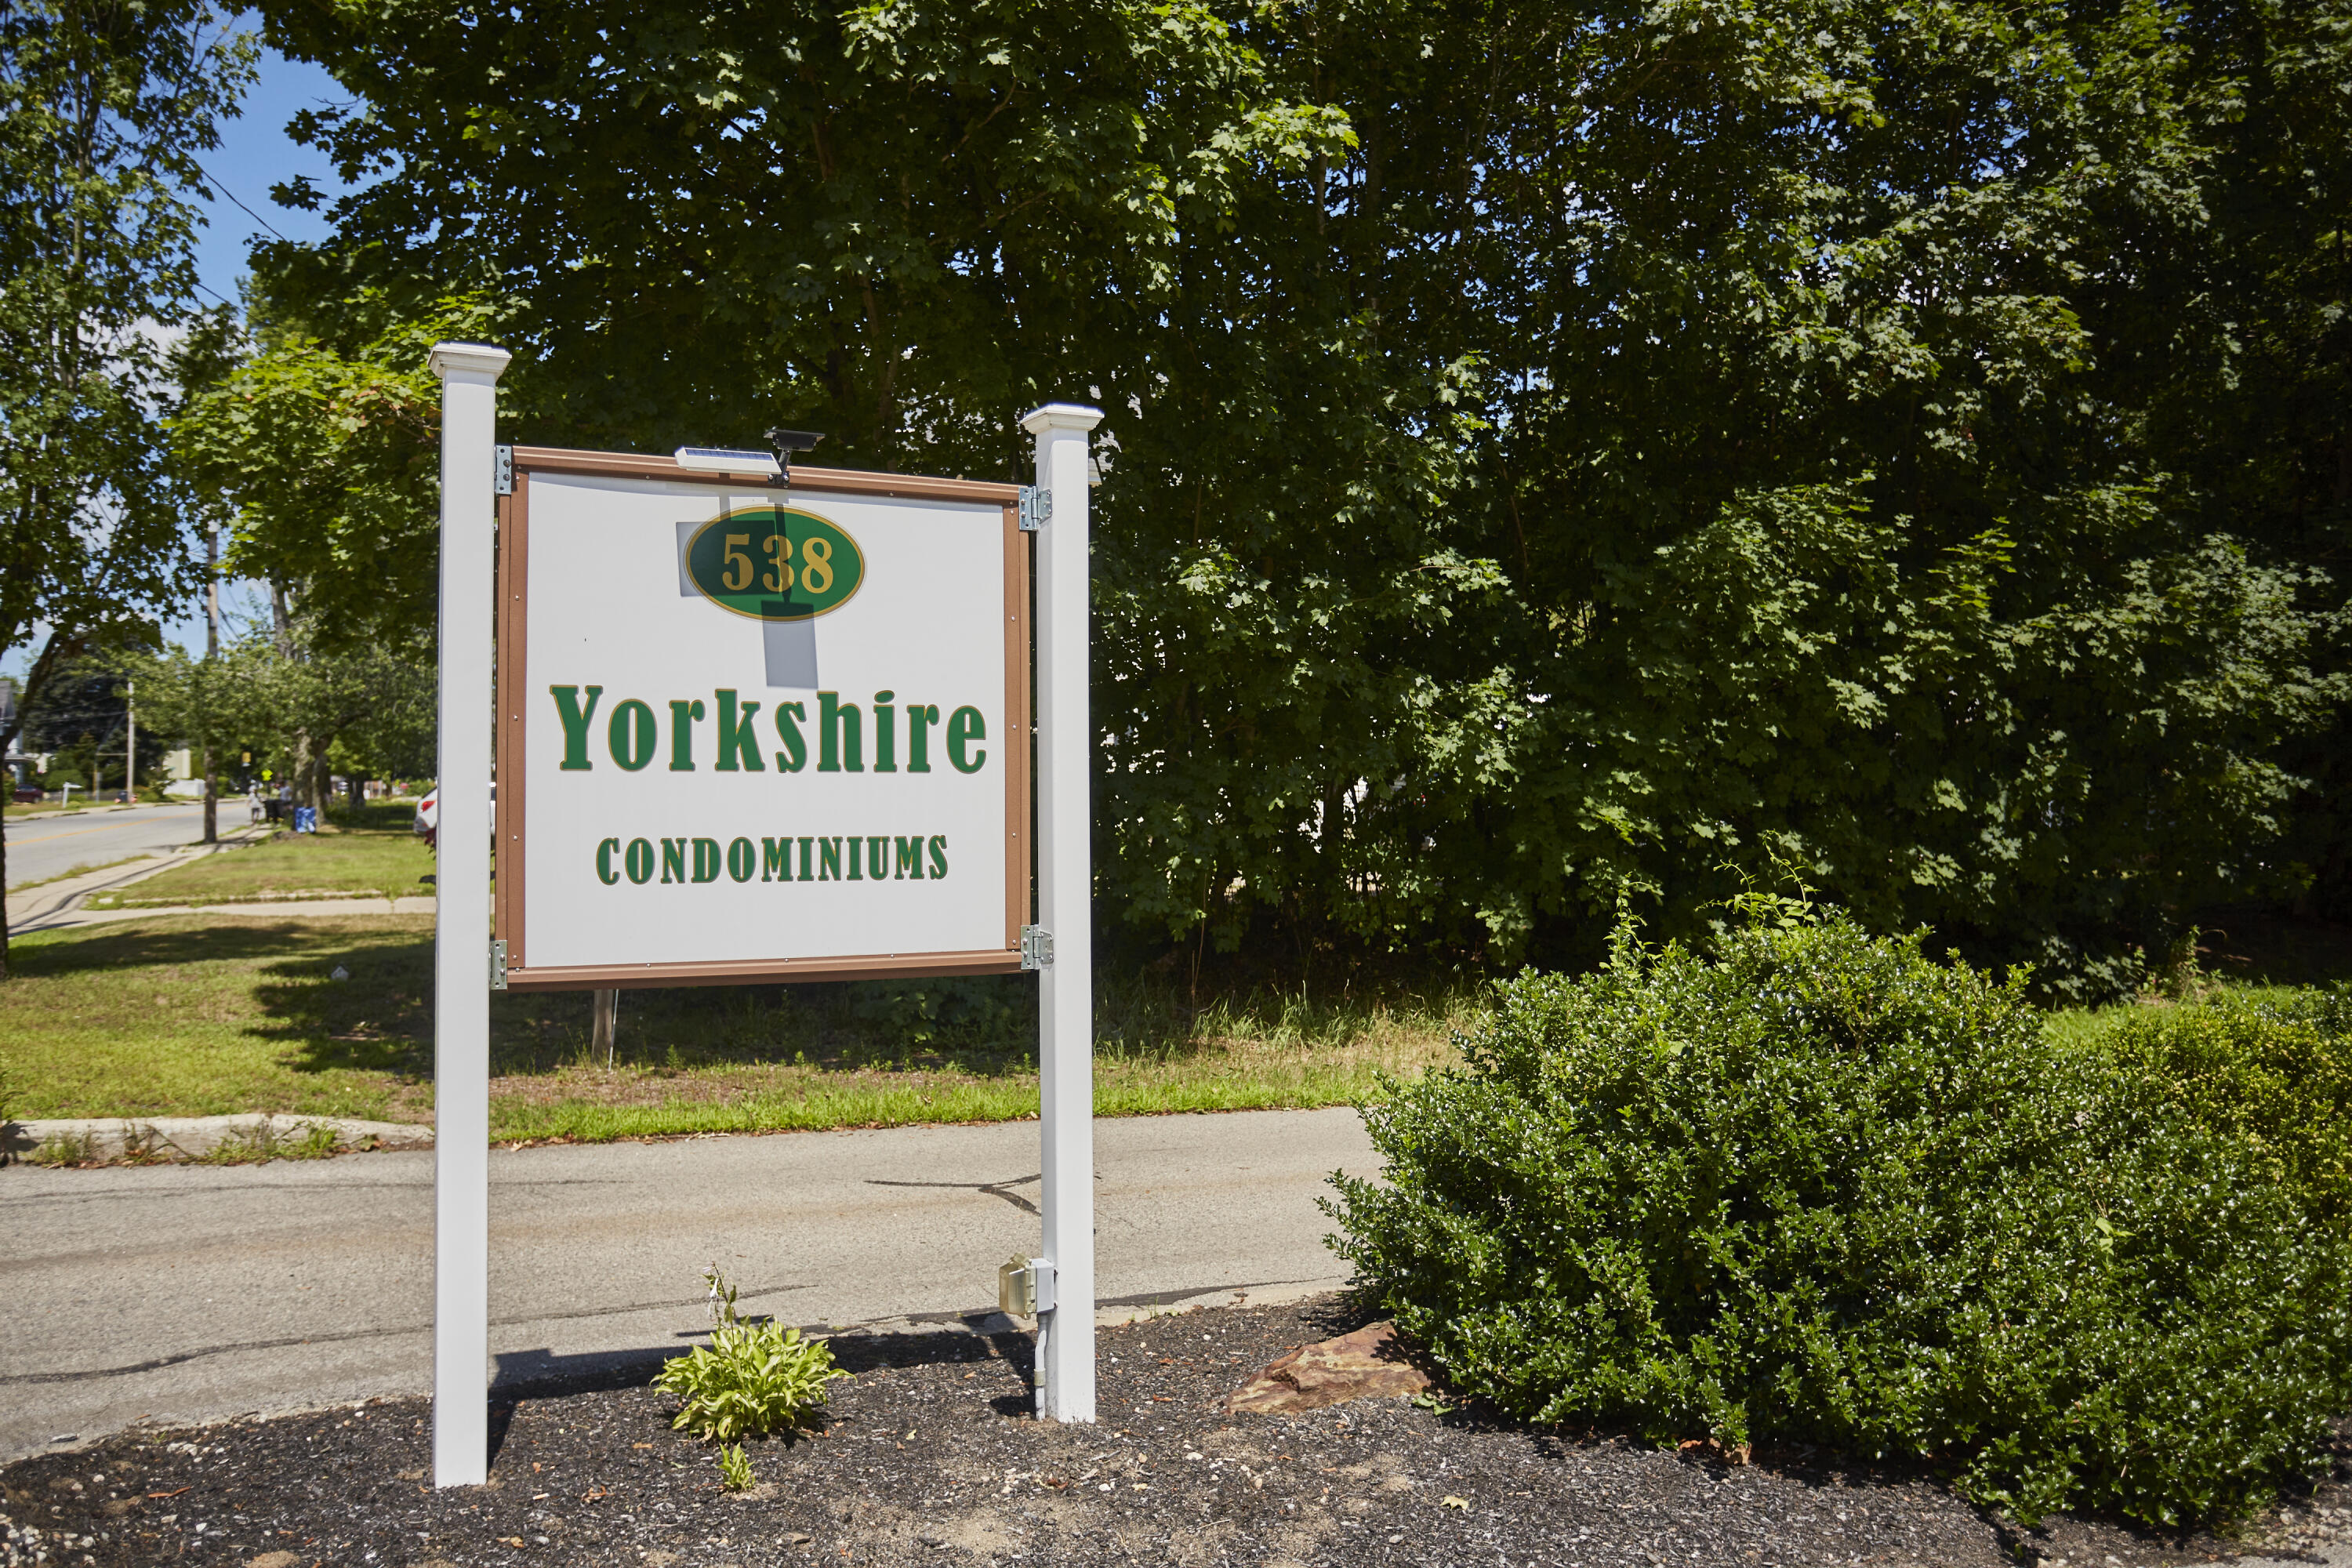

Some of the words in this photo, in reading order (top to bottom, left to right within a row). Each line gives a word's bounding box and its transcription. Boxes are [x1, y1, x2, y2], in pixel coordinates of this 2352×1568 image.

[721, 533, 834, 593] 538
[550, 684, 987, 774] Yorkshire
[596, 835, 949, 885] CONDOMINIUMS
